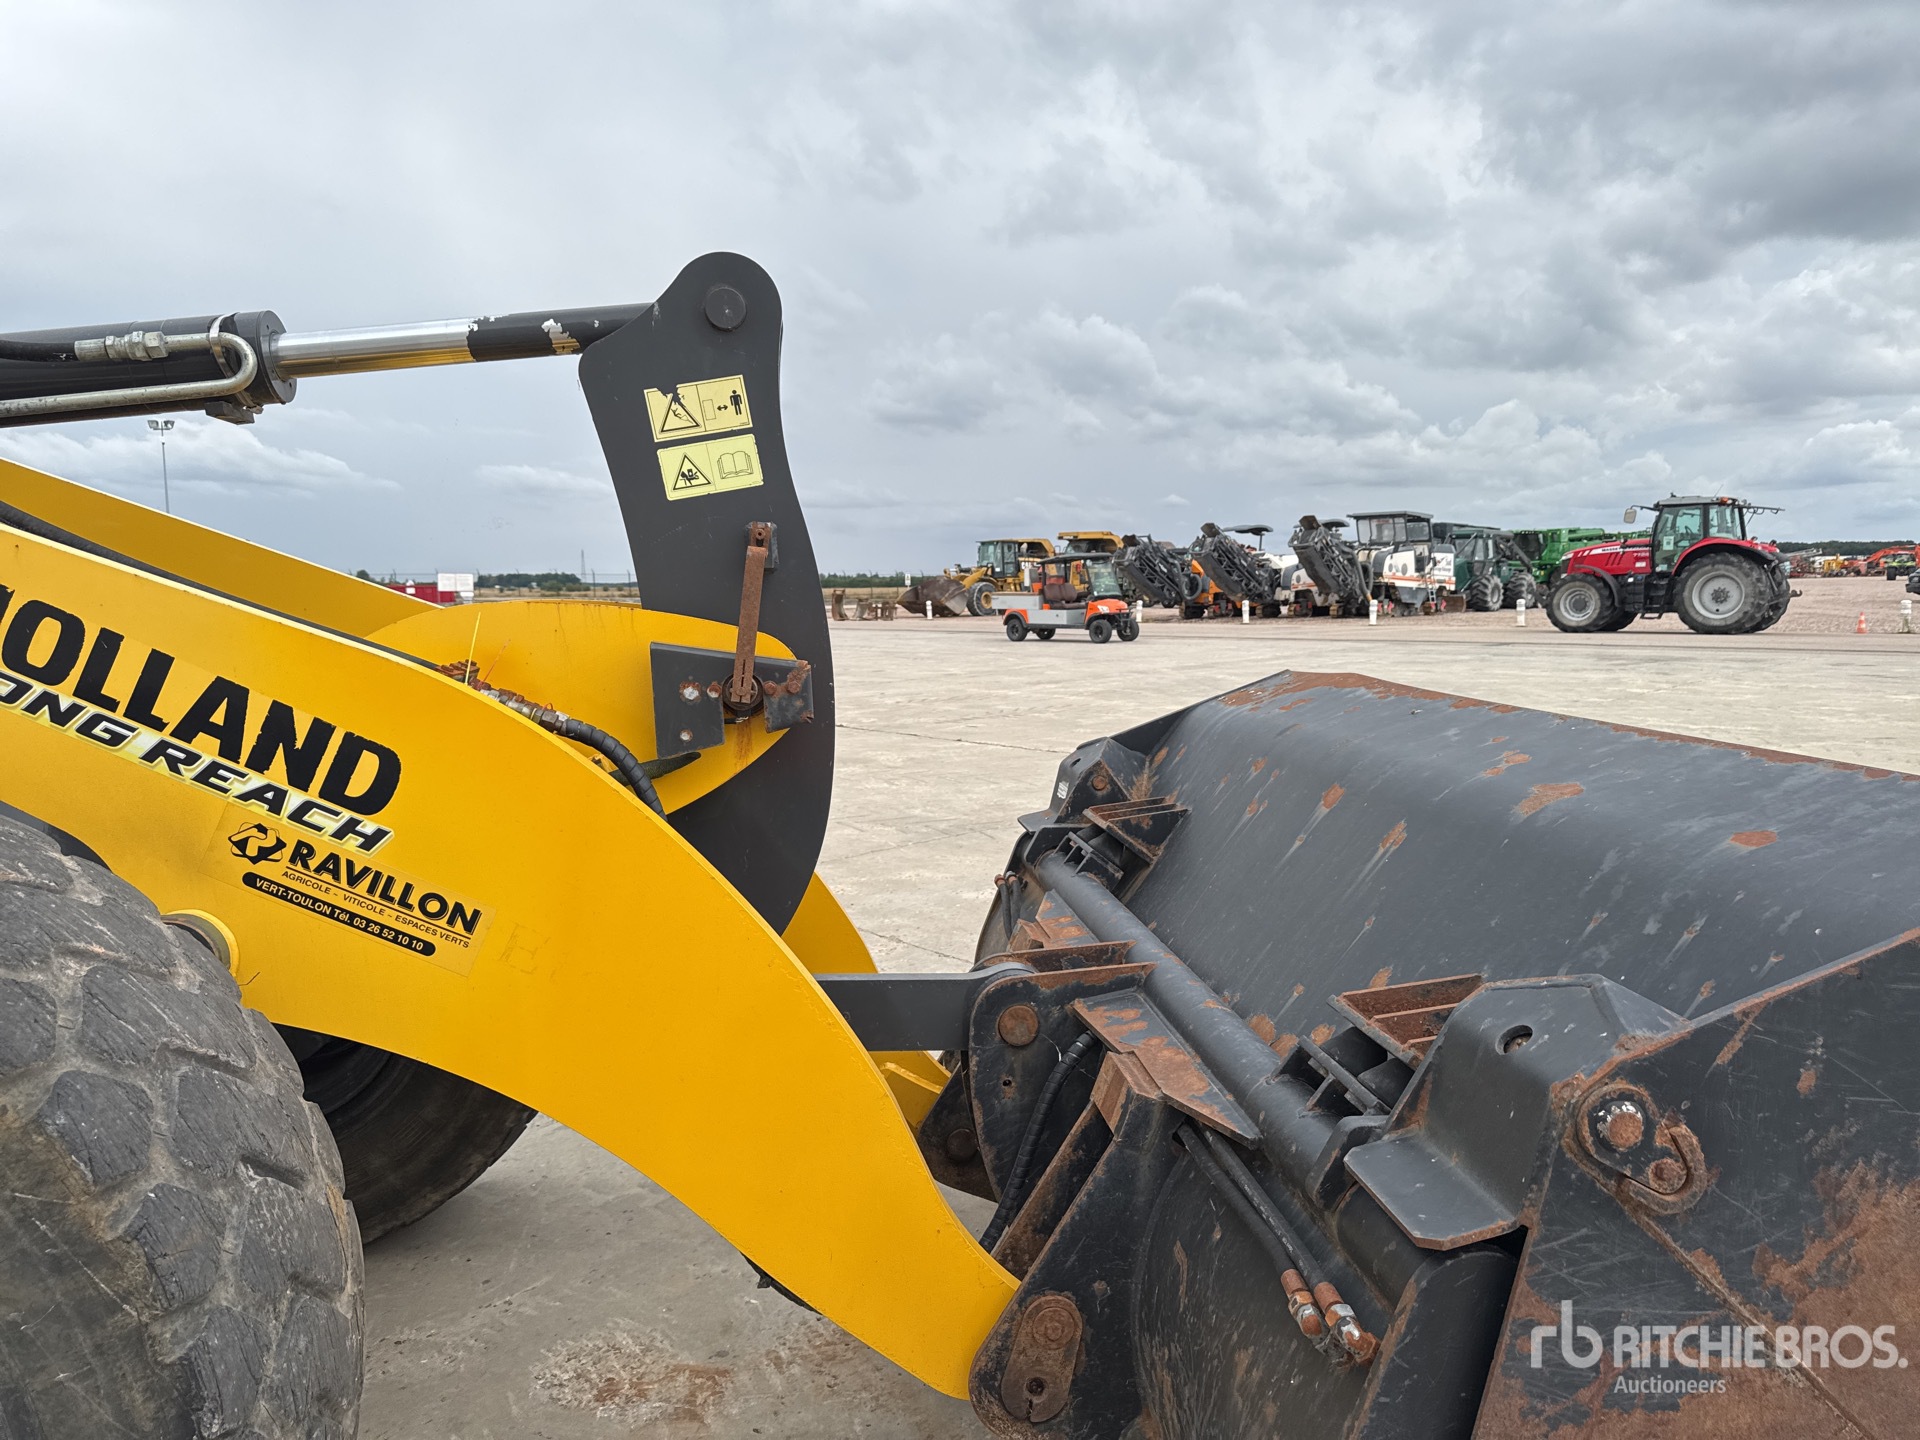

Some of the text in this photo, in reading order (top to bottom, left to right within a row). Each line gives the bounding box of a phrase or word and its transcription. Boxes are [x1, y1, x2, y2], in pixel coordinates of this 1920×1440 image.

[139, 738, 392, 853] REACH
[255, 877, 424, 951] VERT-TOULON Tél. 03 26 52 10 10
[281, 870, 331, 895] AGRICOLE
[343, 893, 385, 917] VITICOLE
[395, 914, 438, 936] ESPACES
[439, 931, 470, 949] VERTS
[288, 838, 482, 935] RAVILLON
